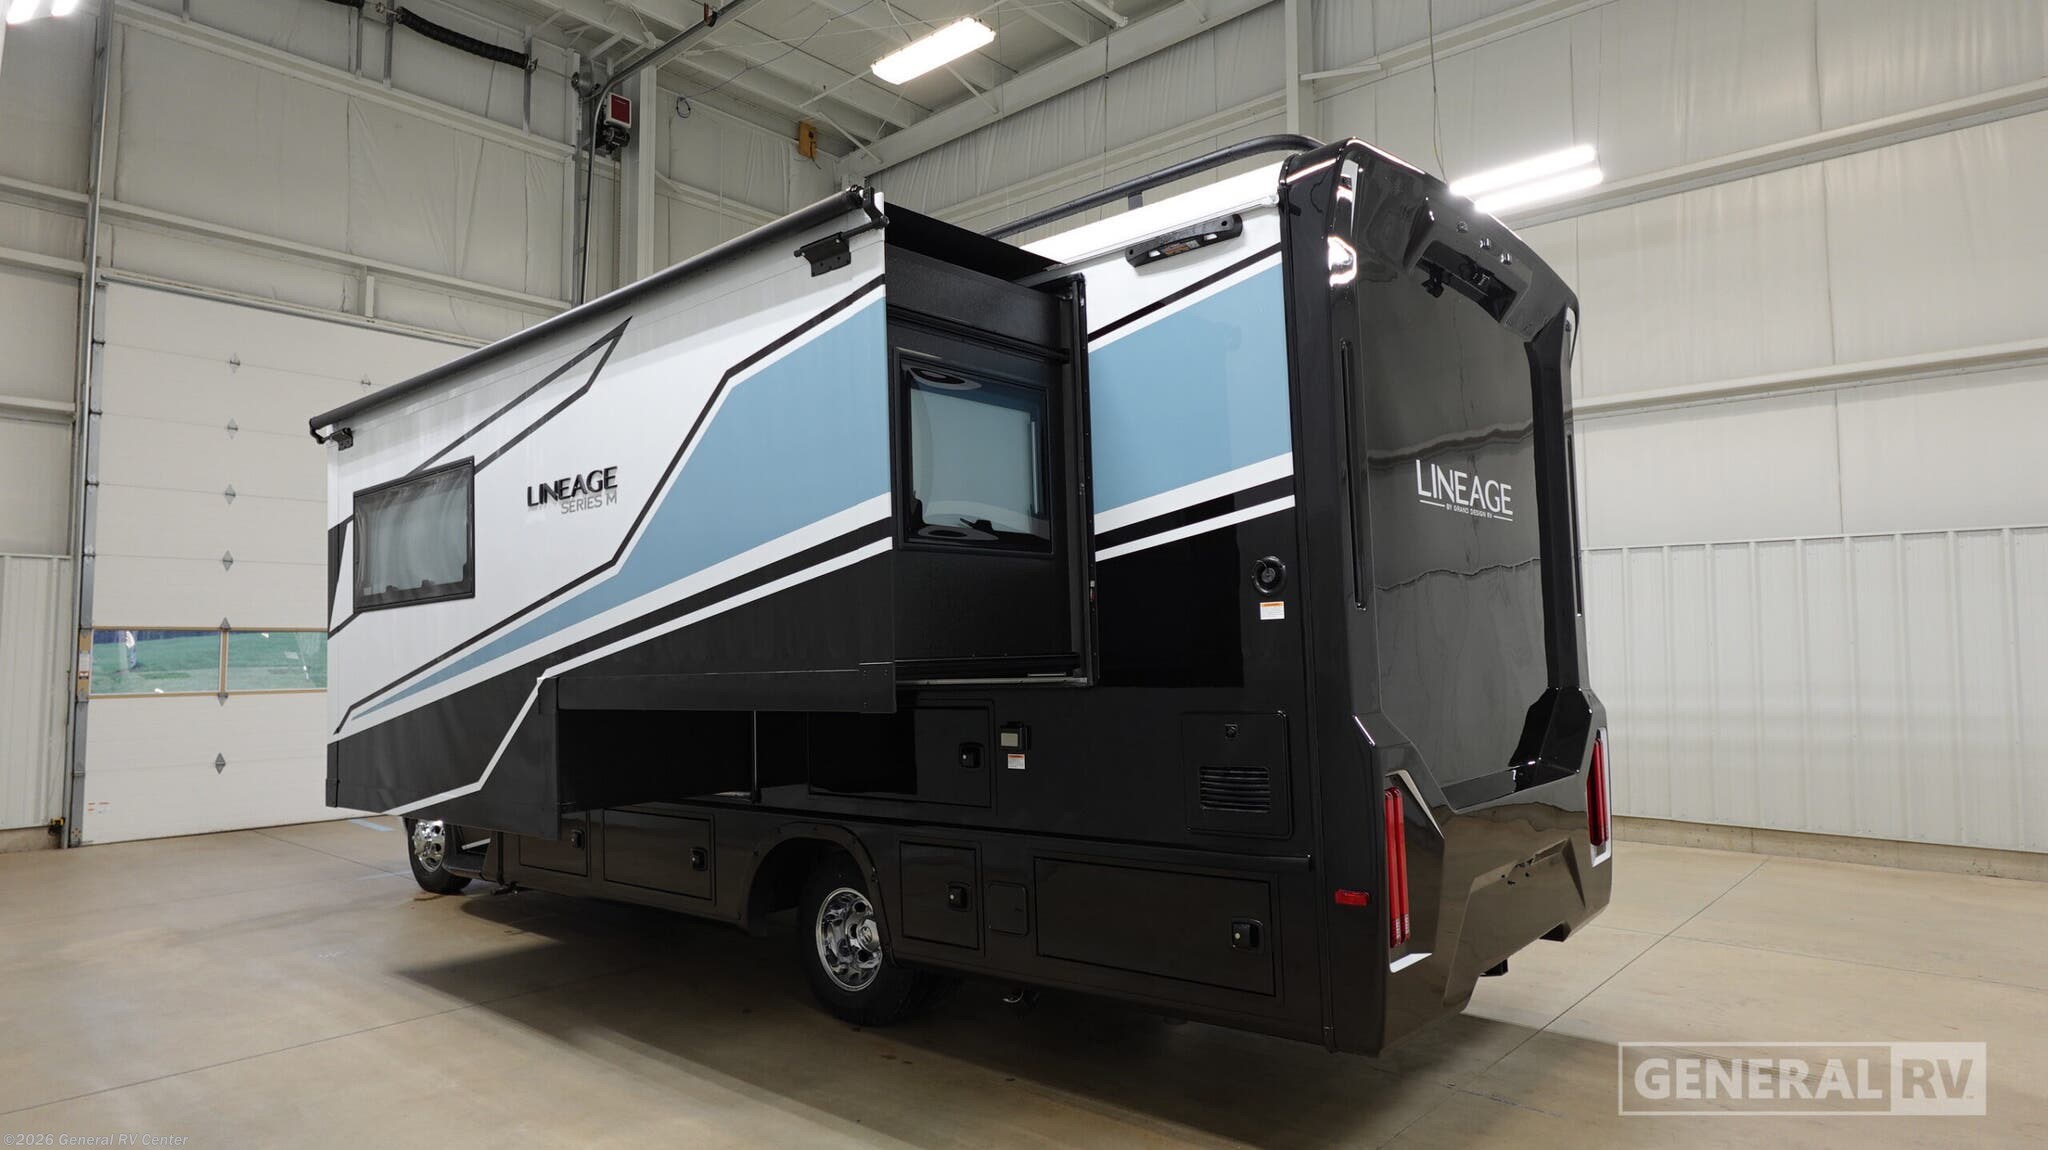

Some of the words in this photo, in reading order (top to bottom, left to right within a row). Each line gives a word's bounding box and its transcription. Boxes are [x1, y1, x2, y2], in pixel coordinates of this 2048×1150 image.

[527, 466, 618, 507] LINEAGE
[561, 496, 603, 514] SERIES
[606, 491, 617, 506] M
[1416, 459, 1513, 515] LINEAGE
